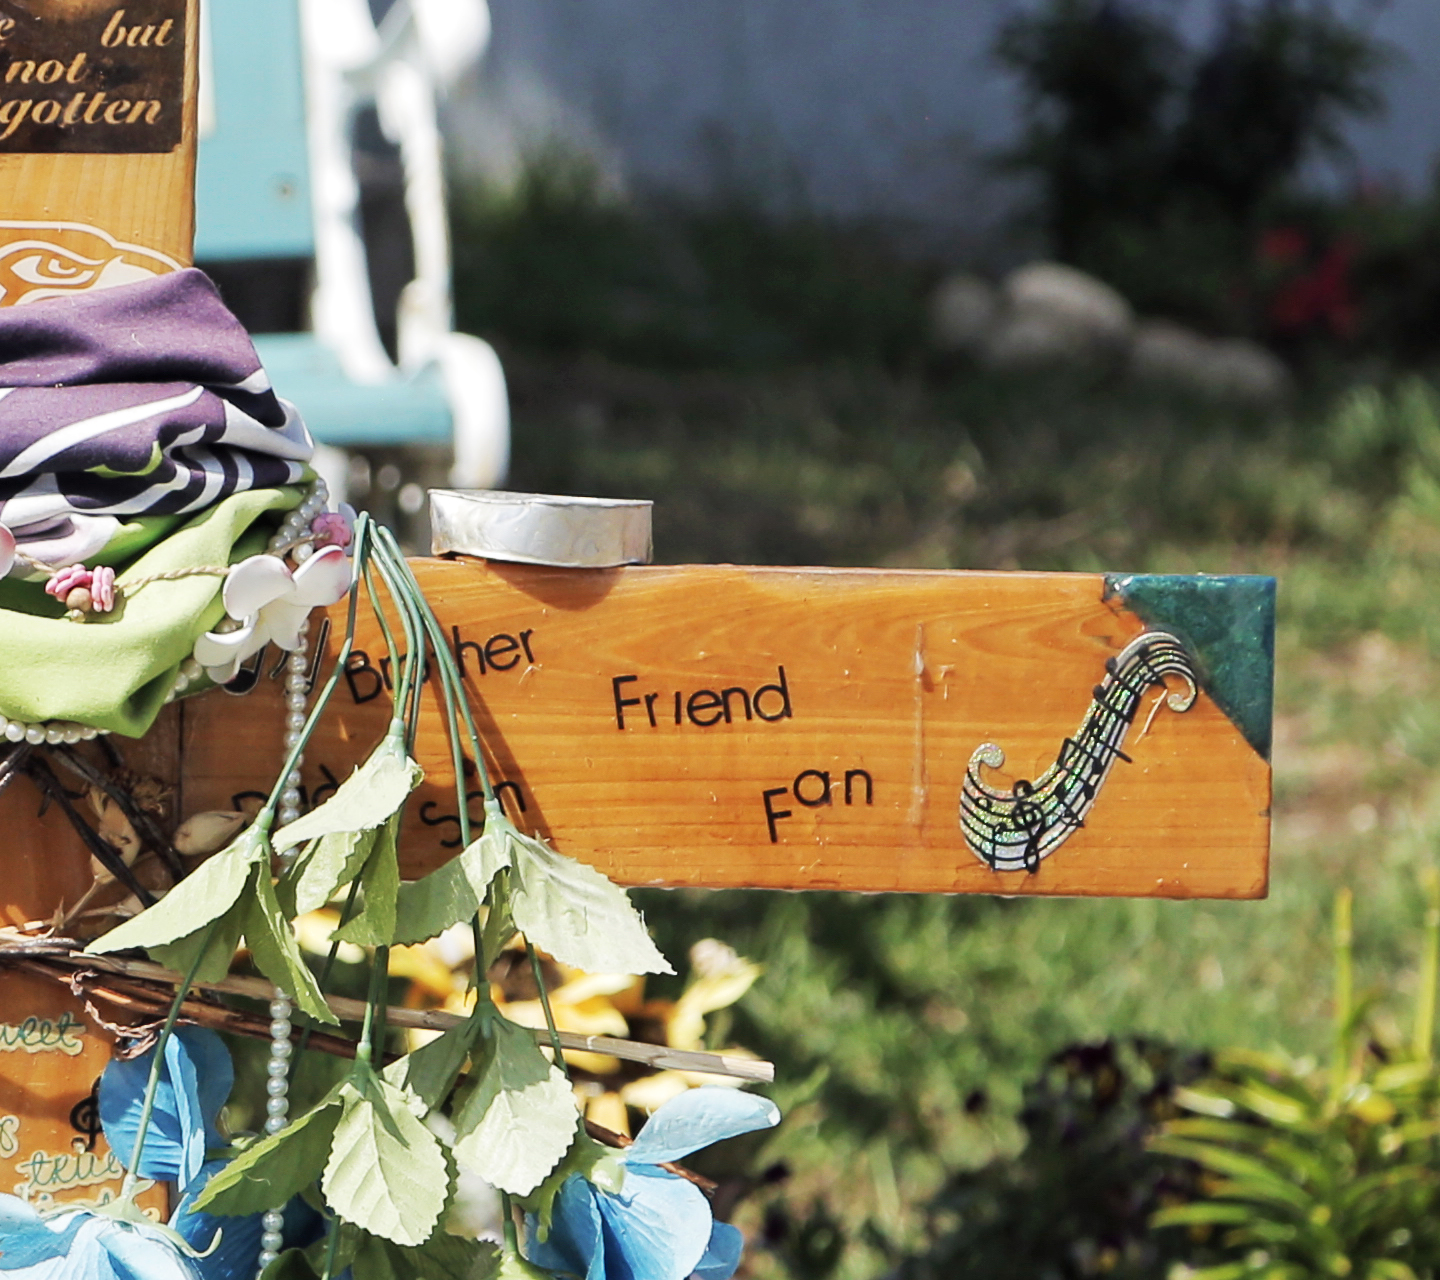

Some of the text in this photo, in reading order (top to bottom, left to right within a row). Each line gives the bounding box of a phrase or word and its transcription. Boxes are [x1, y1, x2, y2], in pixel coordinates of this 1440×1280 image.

[100, 9, 174, 48] but
[5, 52, 88, 84] not
[343, 624, 535, 705] Broher
[612, 665, 793, 730] Friend
[763, 769, 873, 843] Fan
